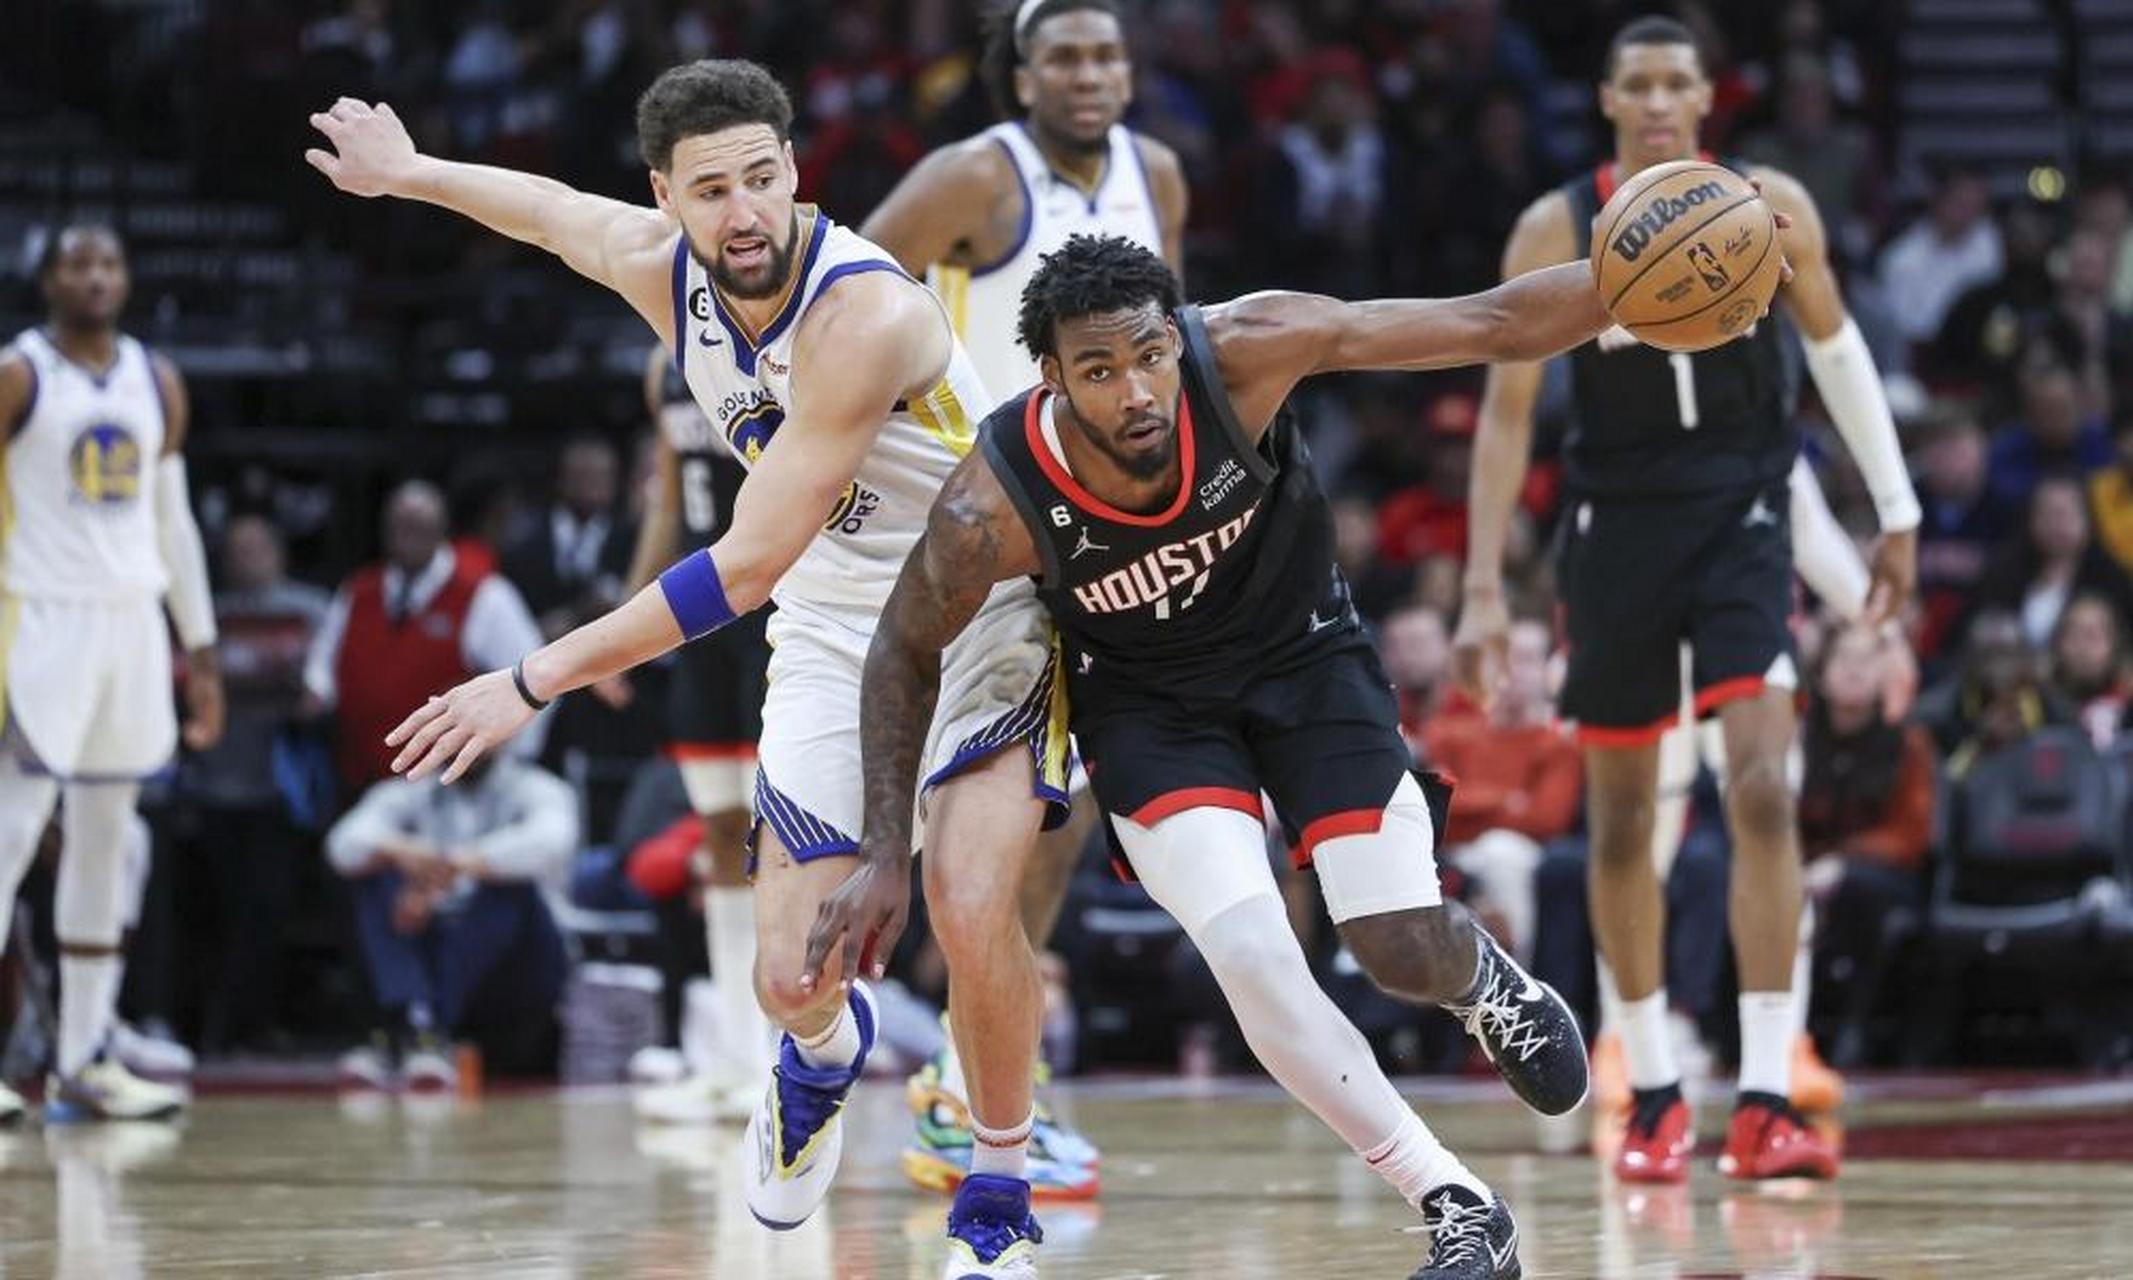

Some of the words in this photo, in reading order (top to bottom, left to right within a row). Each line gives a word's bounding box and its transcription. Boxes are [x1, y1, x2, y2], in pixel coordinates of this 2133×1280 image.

[1612, 181, 1725, 262] Wilson
[1200, 459, 1238, 497] credit
[1202, 469, 1247, 511] karma
[1050, 505, 1072, 528] 6
